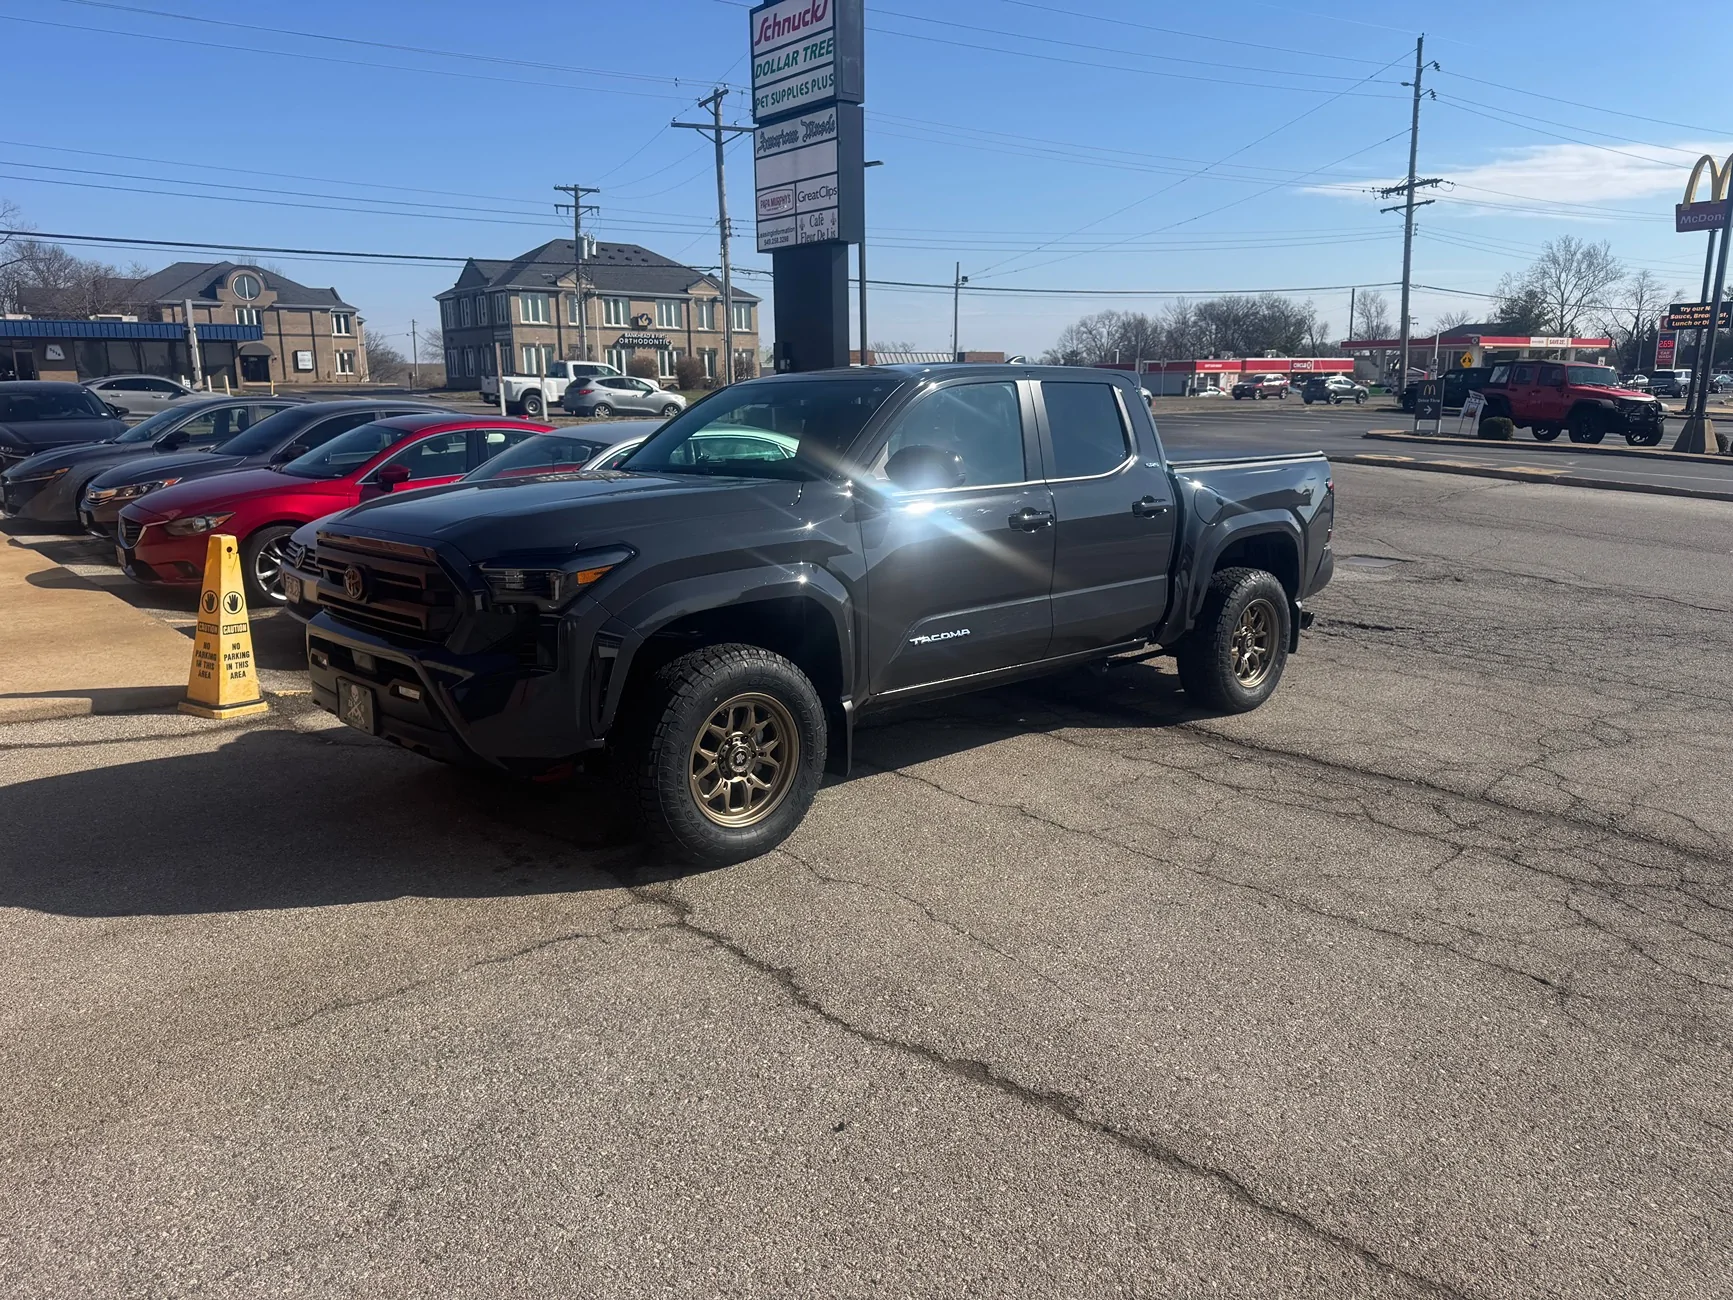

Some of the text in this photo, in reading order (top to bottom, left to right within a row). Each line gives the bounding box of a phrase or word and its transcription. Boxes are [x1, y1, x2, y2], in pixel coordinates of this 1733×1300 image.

[755, 37, 834, 79] DOLLAR TREE
[755, 73, 834, 110] PET SUPPLIES PLUS
[618, 338, 673, 346] ORTHODONTICS
[199, 622, 218, 634] CAUTION
[223, 624, 247, 635] CAUTION
[909, 628, 971, 645] TACOMA
[203, 641, 211, 650] NO
[232, 643, 241, 651] NO
[195, 649, 217, 662] PARKING
[224, 651, 250, 662] PARKING
[196, 659, 215, 671] IN THIS
[235, 660, 249, 669] THIS
[198, 669, 211, 679] AREA
[230, 670, 246, 679] AREA
